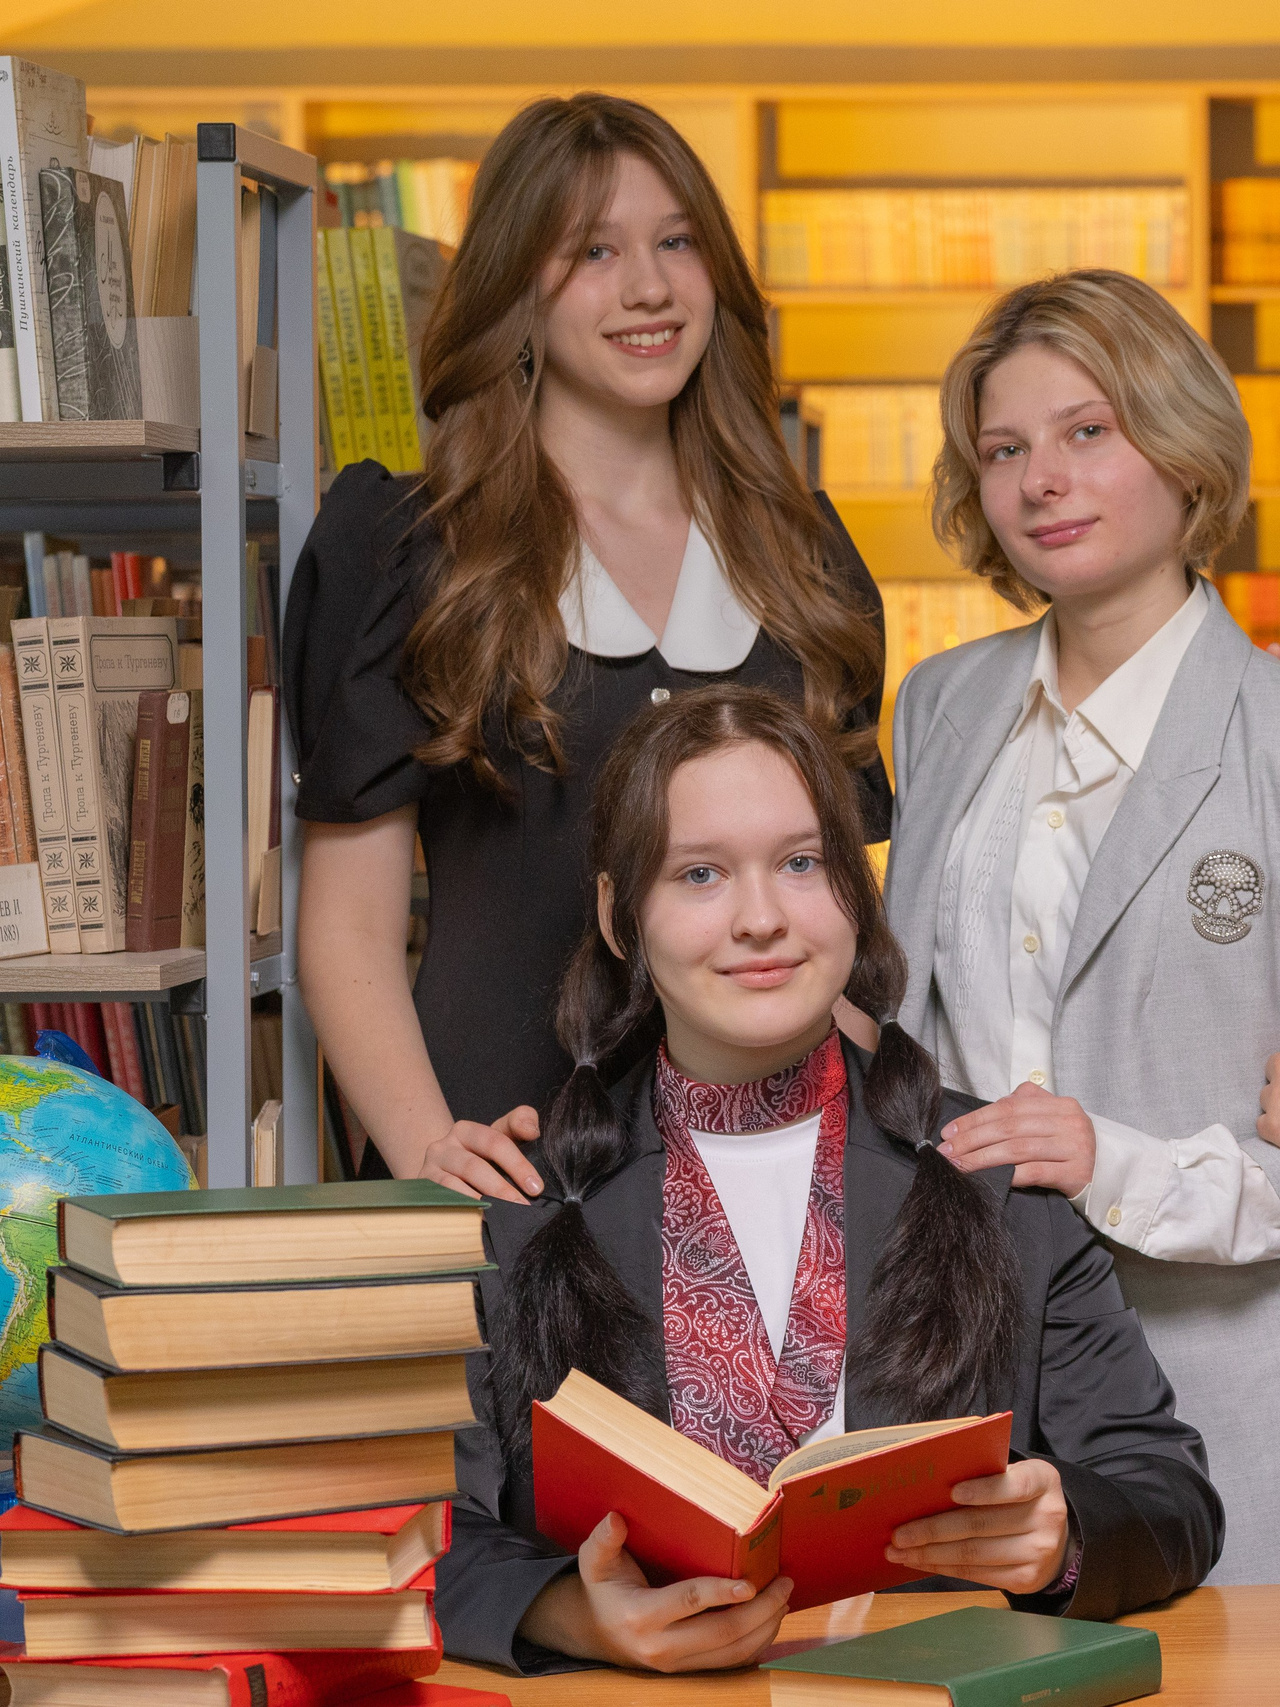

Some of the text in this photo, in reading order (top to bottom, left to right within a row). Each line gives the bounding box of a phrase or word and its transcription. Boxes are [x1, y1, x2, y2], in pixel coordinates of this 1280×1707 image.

[7, 156, 28, 331] Пушкинский календарь
[94, 653, 168, 674] Тропа к Тургеневу
[34, 704, 50, 770] Тургеневу
[69, 704, 88, 822] Тропа к Тургеневу
[42, 787, 55, 822] Тропа
[14, 898, 22, 915] И.
[69, 1134, 168, 1170] АТЛАНТИЧЕСКИЙ ОКЕАН
